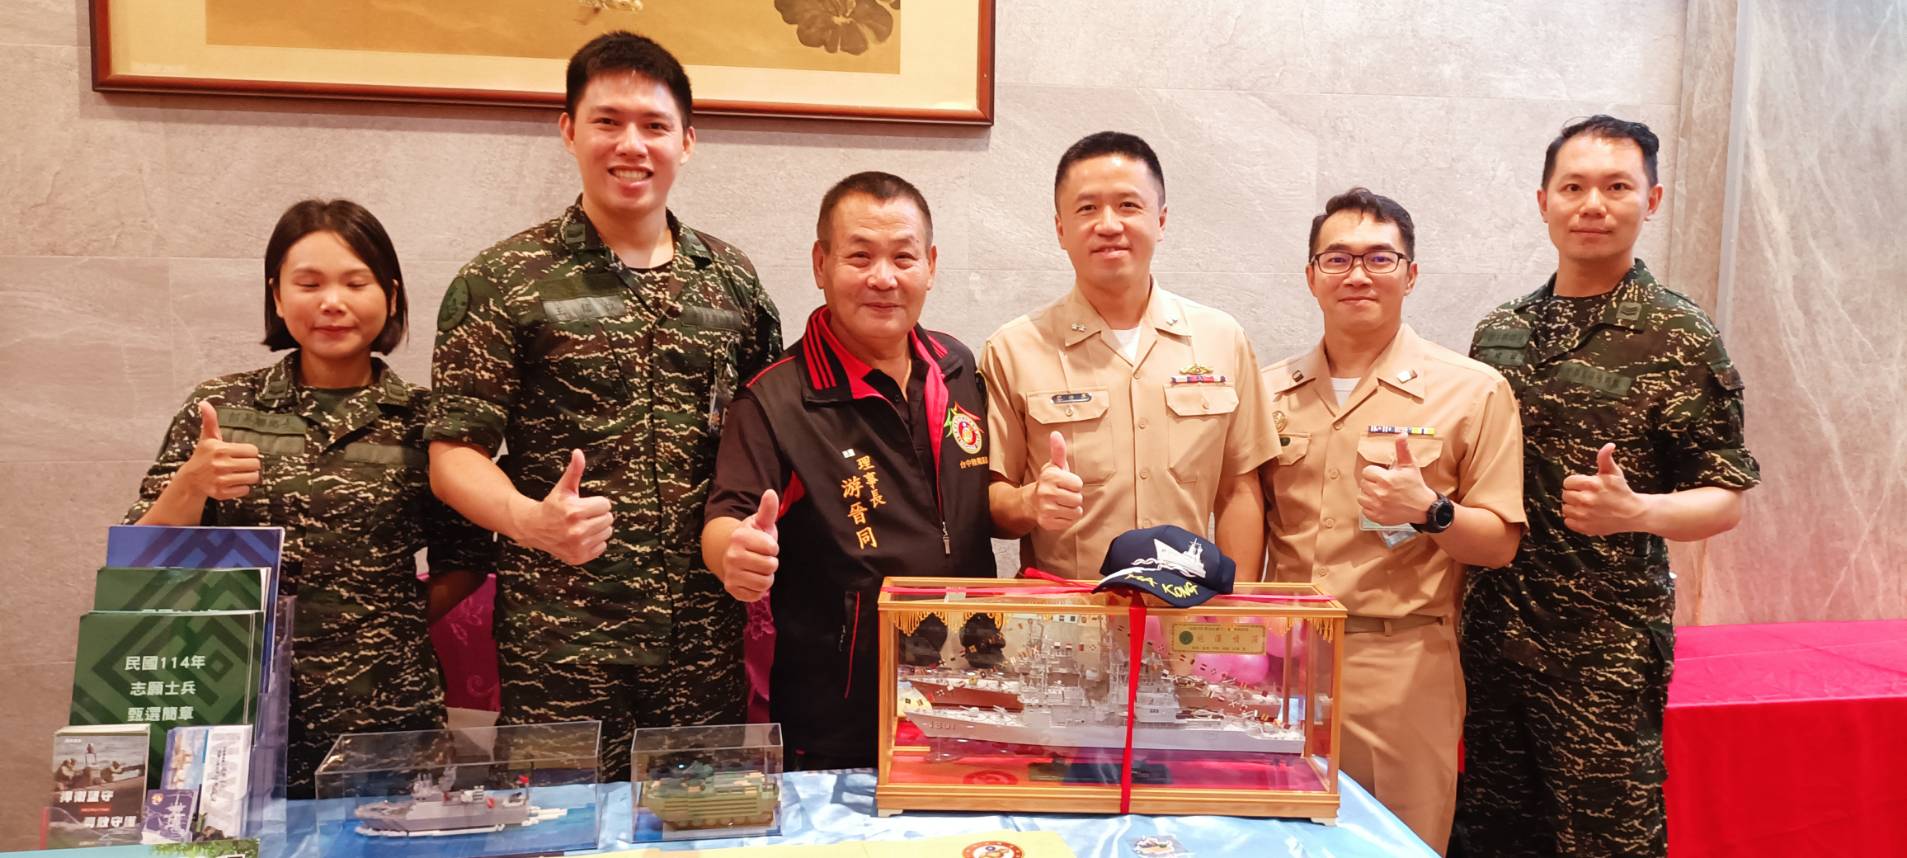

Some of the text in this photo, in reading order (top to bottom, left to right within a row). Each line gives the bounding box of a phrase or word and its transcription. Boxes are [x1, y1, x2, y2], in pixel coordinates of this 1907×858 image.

[856, 455, 886, 509] 理事長
[841, 475, 878, 550] 游晉同
[1161, 581, 1199, 599] KONG
[125, 655, 206, 671] 民國114年
[130, 681, 196, 696] 志願士兵
[127, 706, 194, 721] 甄選簡章
